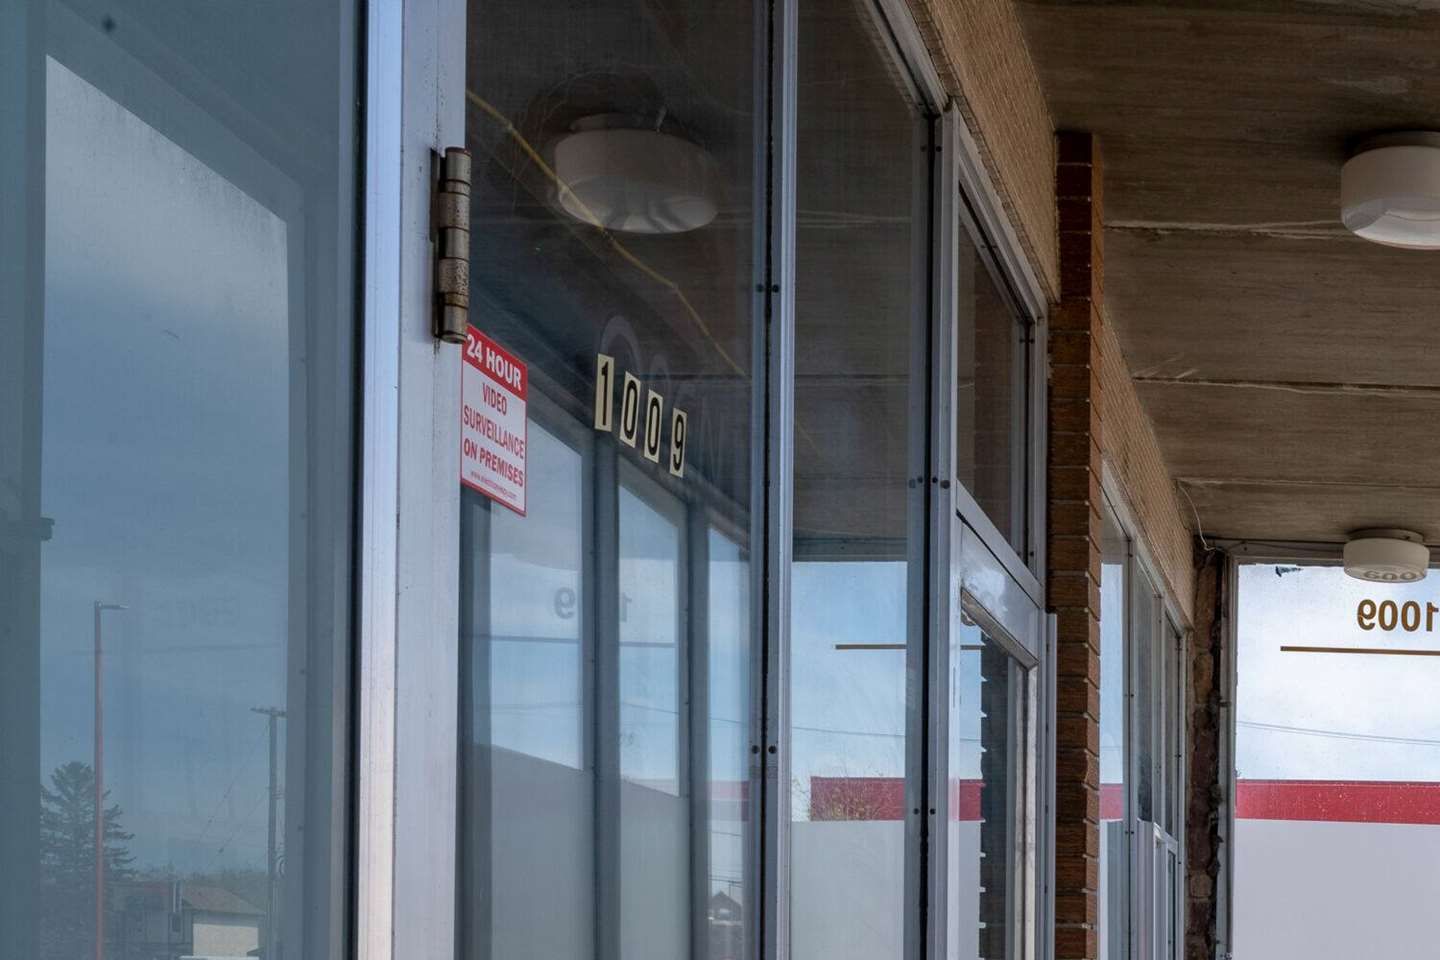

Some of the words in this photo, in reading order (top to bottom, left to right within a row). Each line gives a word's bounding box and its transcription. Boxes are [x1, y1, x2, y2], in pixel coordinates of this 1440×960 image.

[467, 334, 483, 363] 24
[486, 346, 522, 391] HOUR
[482, 382, 507, 416] VIDEO
[600, 360, 685, 472] 1009
[463, 405, 525, 460] SURVEILLANCE
[463, 438, 478, 461] ON
[480, 447, 524, 488] PREMISES
